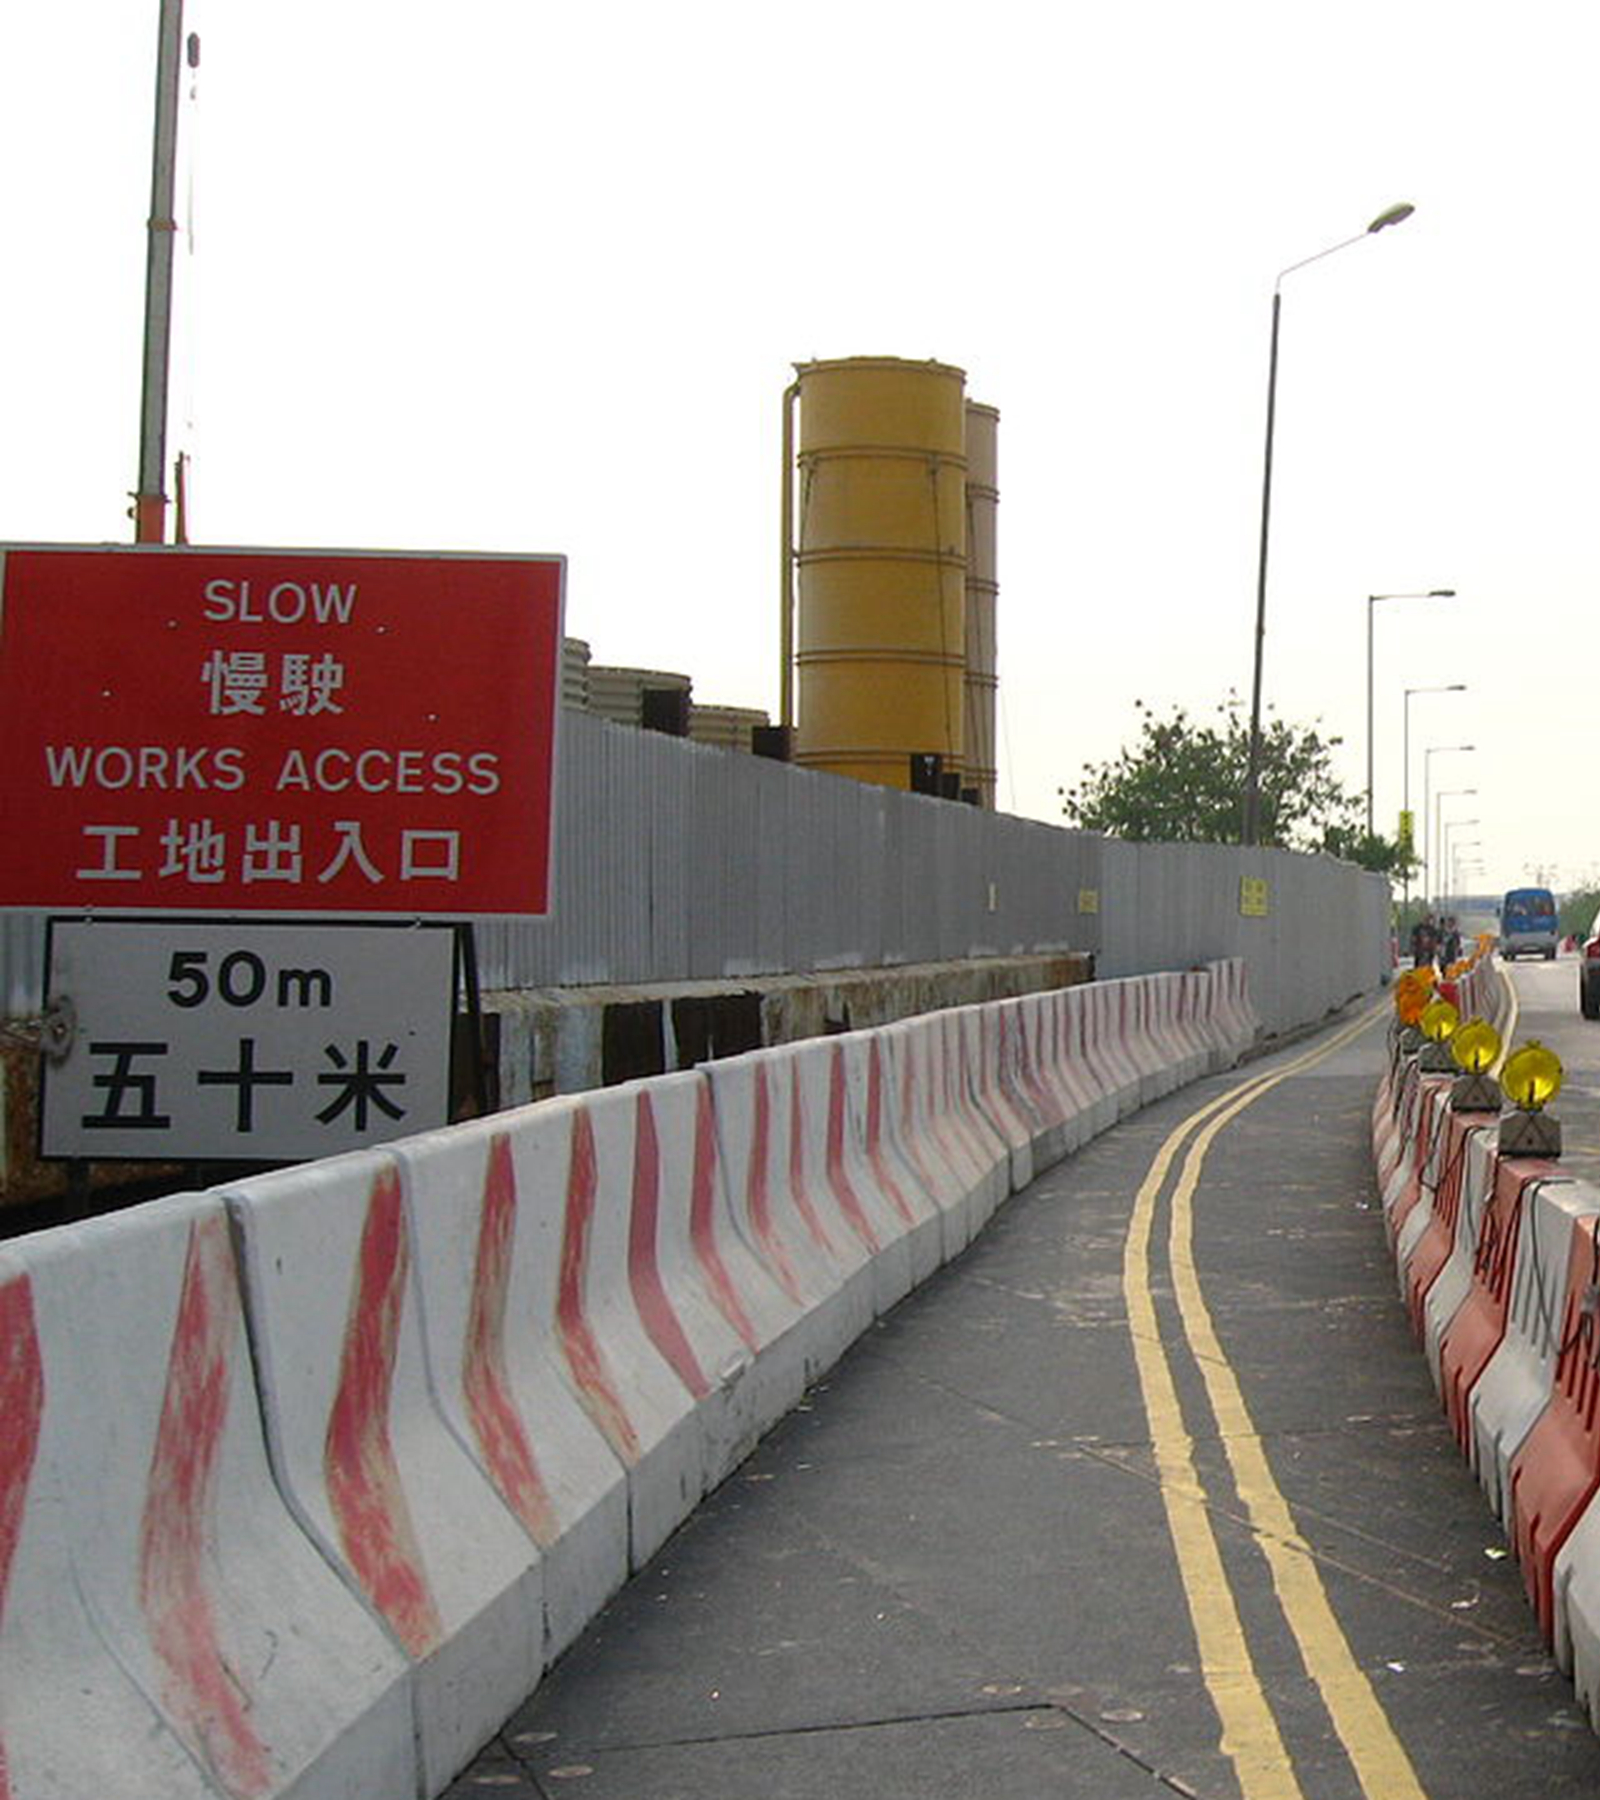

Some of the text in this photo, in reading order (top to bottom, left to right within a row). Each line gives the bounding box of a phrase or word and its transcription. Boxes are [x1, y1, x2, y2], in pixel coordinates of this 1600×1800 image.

[203, 579, 357, 624] SLOW
[201, 650, 345, 716] 慢駛
[45, 746, 501, 796] WORKS ACCESS
[76, 819, 460, 884] 工地出入口
[168, 951, 332, 1008] 50m
[81, 1038, 407, 1132] 五十米
